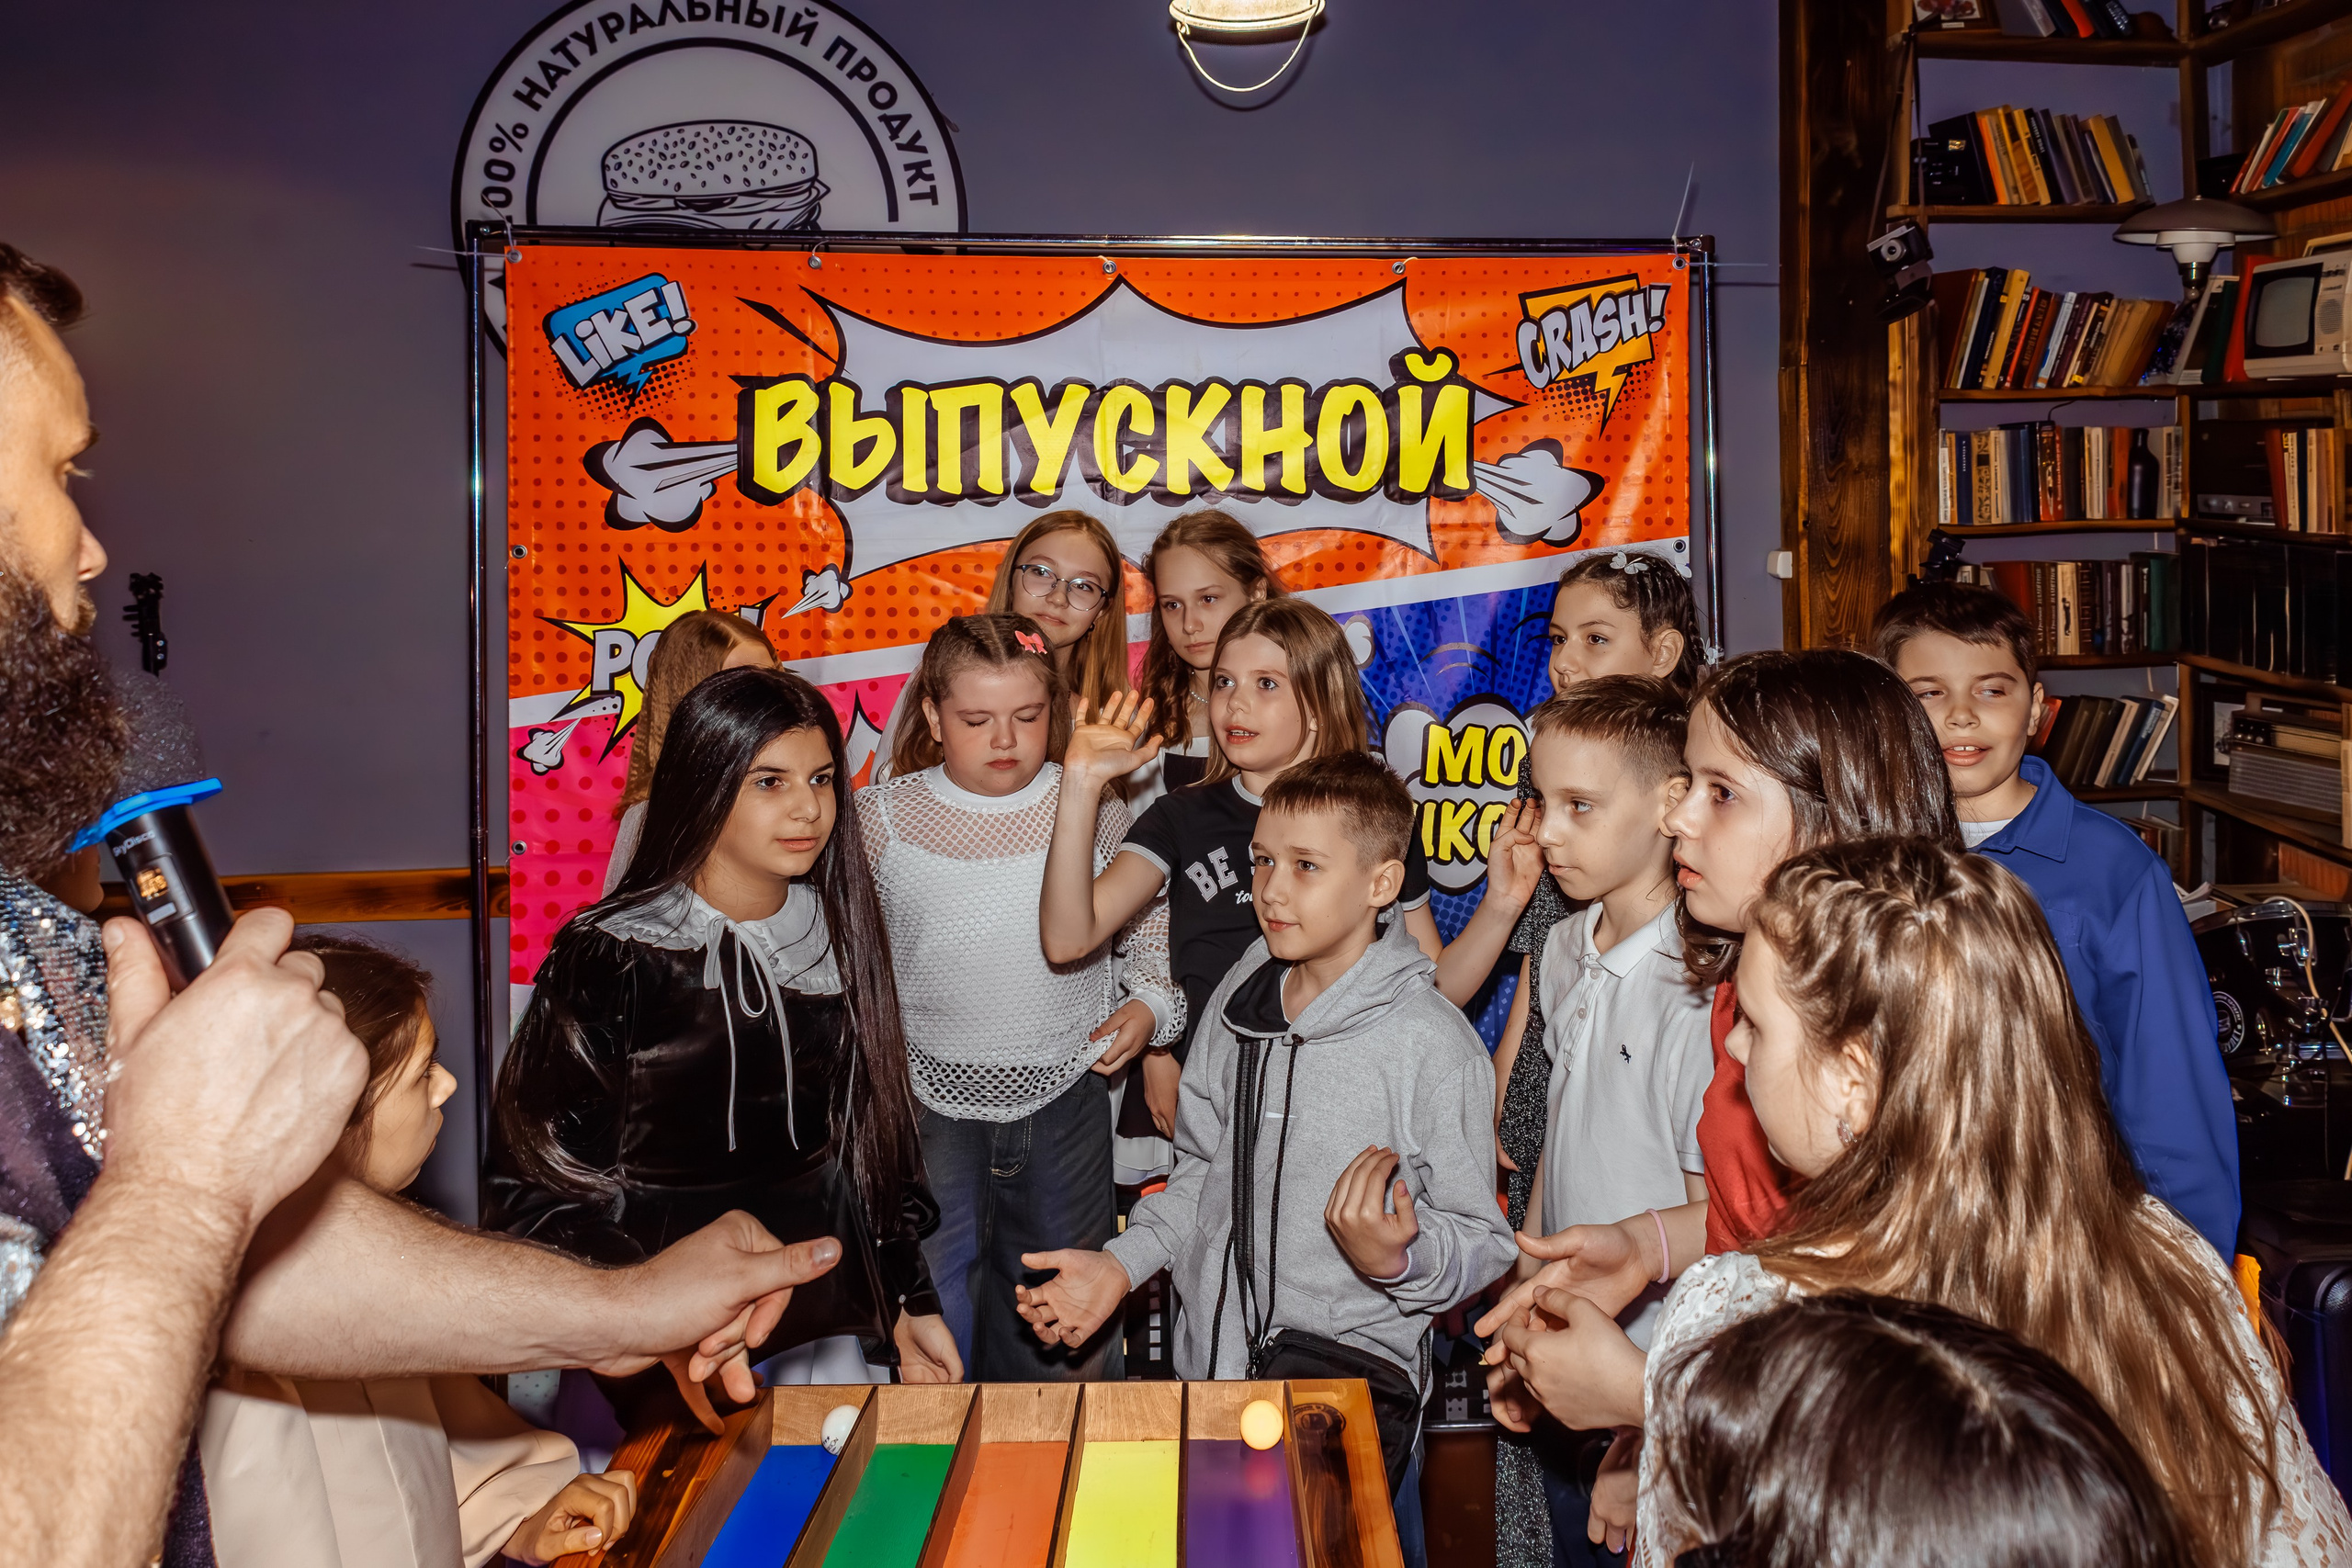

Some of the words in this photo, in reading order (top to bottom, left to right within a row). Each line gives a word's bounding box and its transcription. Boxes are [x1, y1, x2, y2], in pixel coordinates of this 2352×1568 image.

[481, 122, 529, 223] 00%
[513, 0, 819, 112] НАТУРАЛЬНЫЙ
[822, 35, 939, 206] ПРОДУКТ
[1517, 287, 1667, 389] CRASH!
[749, 351, 1472, 497] ВЫПУСКНОЙ
[1425, 724, 1527, 785] МО
[1185, 846, 1238, 902] BE
